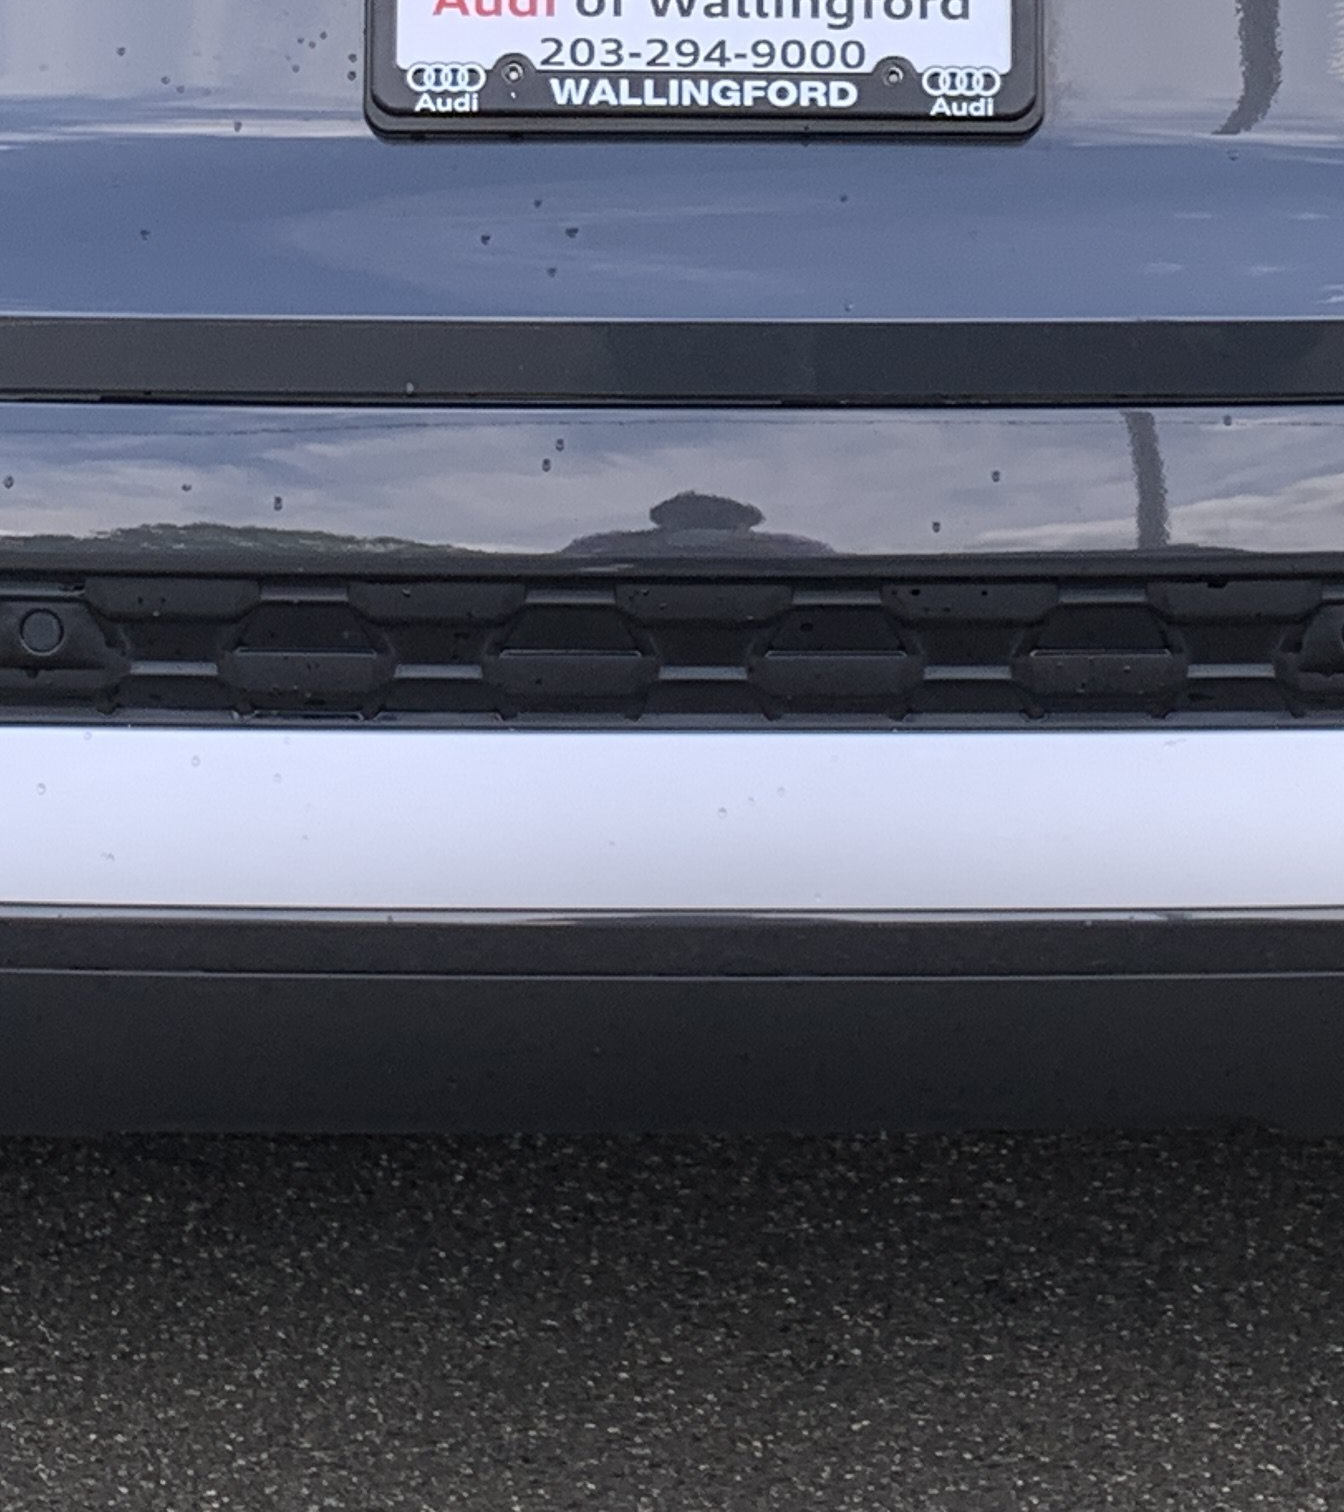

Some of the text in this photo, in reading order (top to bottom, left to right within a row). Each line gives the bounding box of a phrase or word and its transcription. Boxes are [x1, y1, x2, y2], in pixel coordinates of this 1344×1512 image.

[539, 37, 867, 70] 203-294-9000
[414, 92, 479, 114] Audi
[550, 78, 859, 108] WALLINGFORD
[930, 96, 995, 118] Audi
